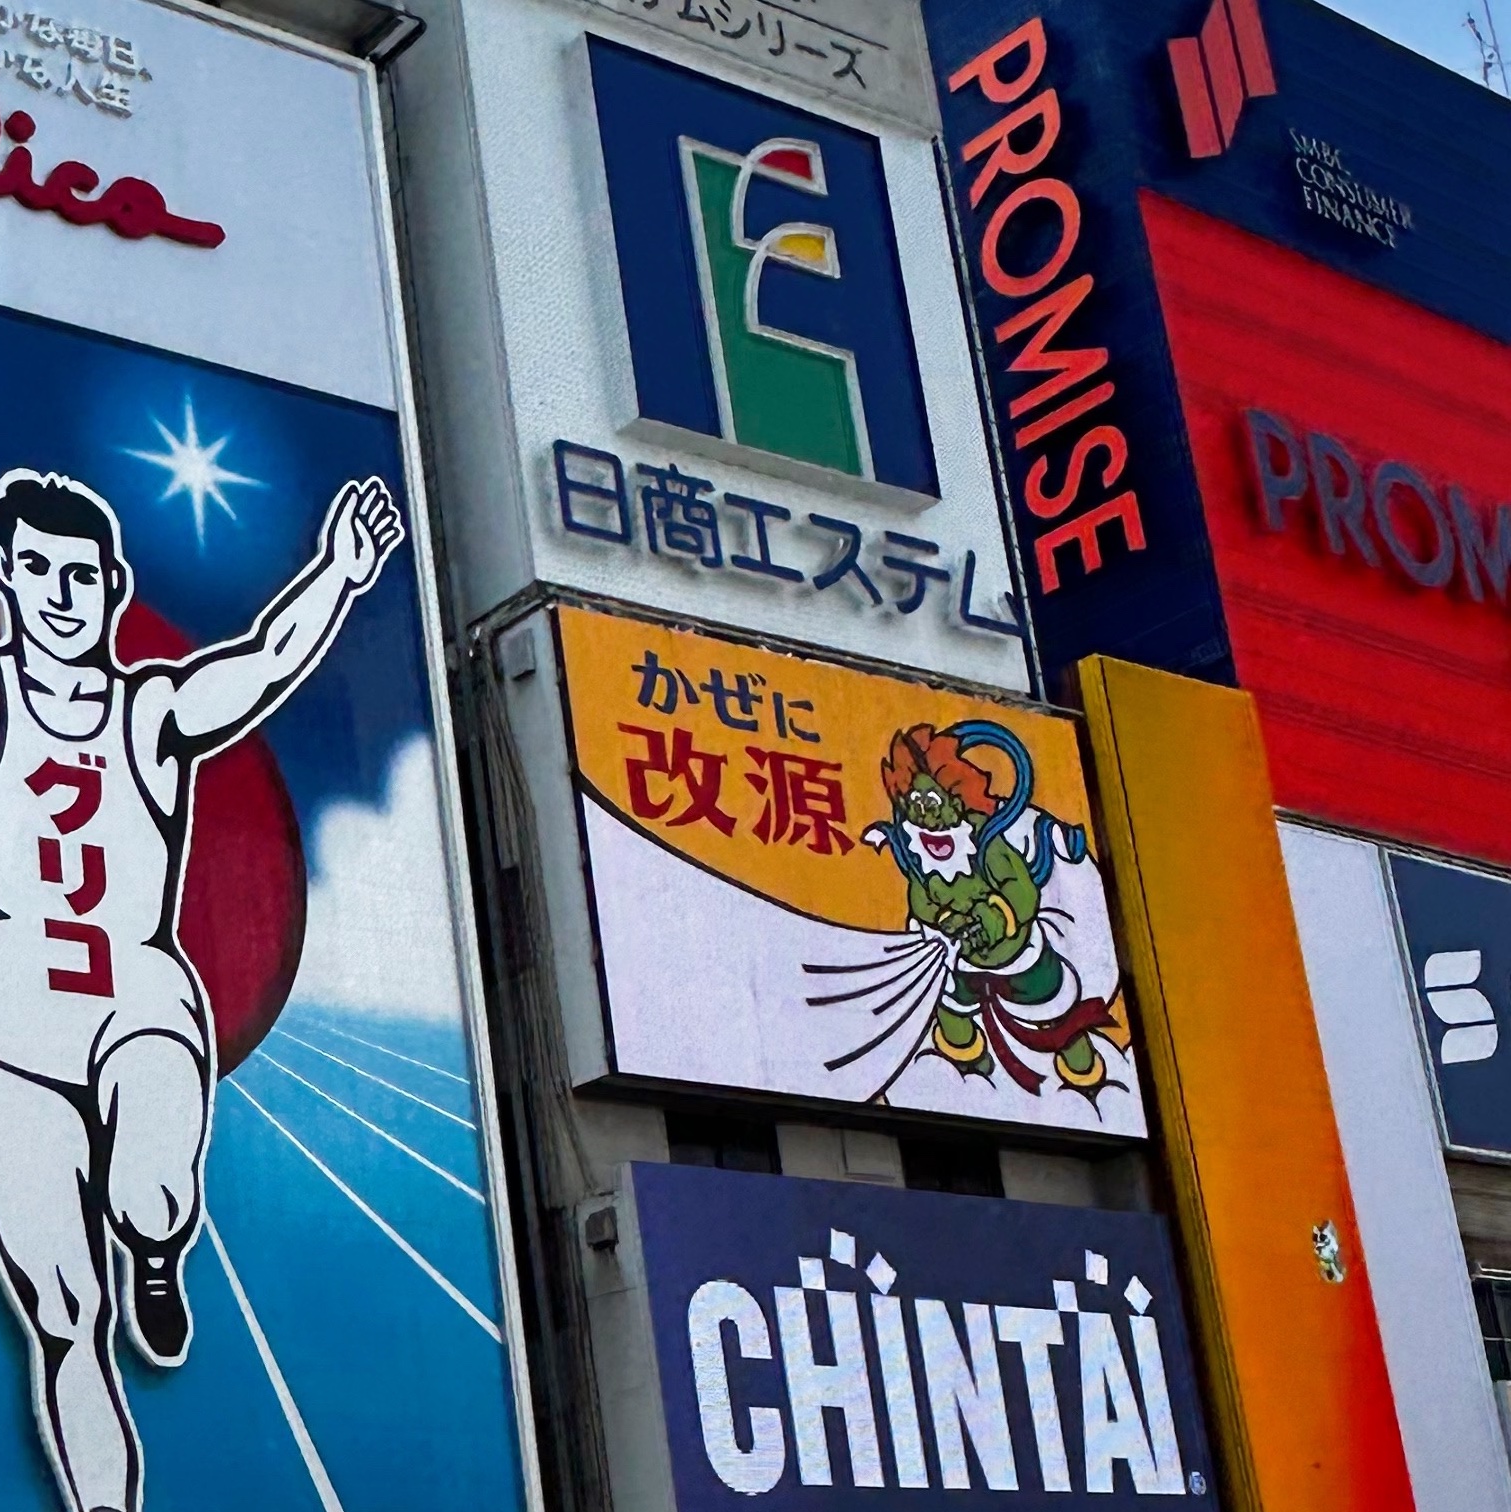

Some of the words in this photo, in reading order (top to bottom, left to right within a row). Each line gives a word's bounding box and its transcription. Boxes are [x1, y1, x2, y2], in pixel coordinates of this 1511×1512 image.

[948, 16, 1147, 595] PROMISE
[552, 438, 1026, 638] 日商エステム
[617, 721, 857, 857] 改源
[630, 649, 823, 743] かぜに
[24, 752, 115, 998] グリコ
[689, 1228, 1187, 1496] CHINTAI
